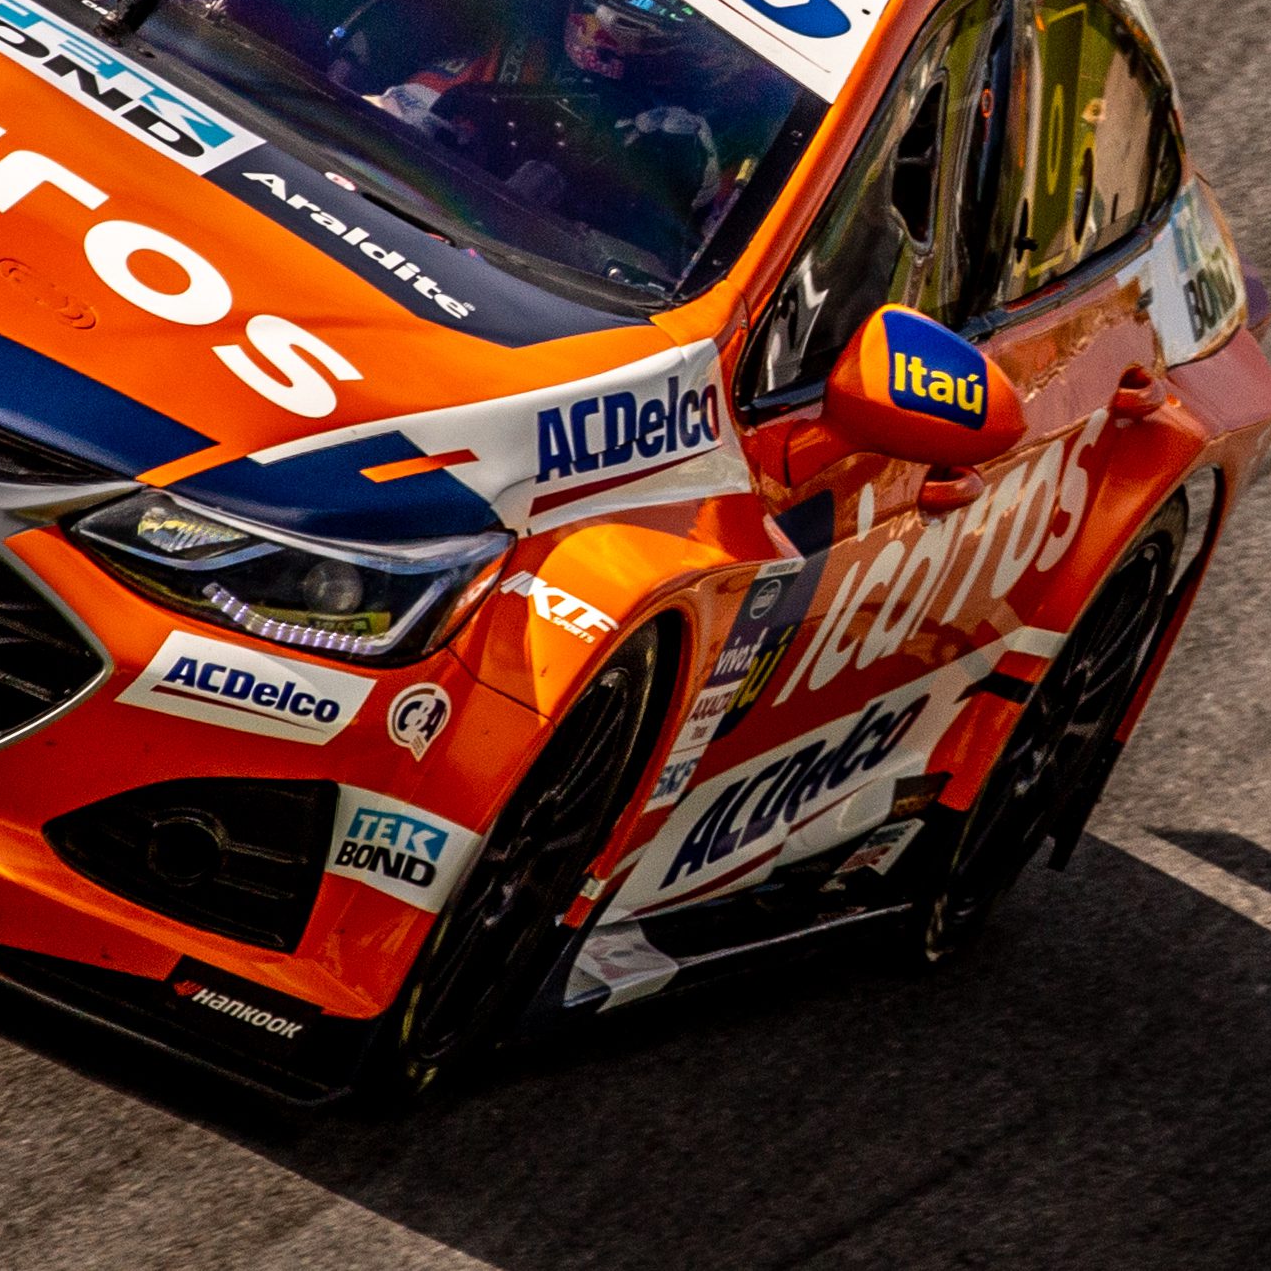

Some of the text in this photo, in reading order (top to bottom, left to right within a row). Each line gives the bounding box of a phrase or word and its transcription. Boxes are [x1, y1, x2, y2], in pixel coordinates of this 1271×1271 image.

[894, 351, 985, 416] Itaú
[534, 377, 719, 484] ACDelco
[771, 408, 1108, 708] icarros
[551, 615, 596, 644] SPORTS
[163, 656, 341, 724] ACDelco
[658, 693, 931, 891] ACDelco
[334, 840, 437, 889] BOND
[347, 807, 449, 862] TEK
